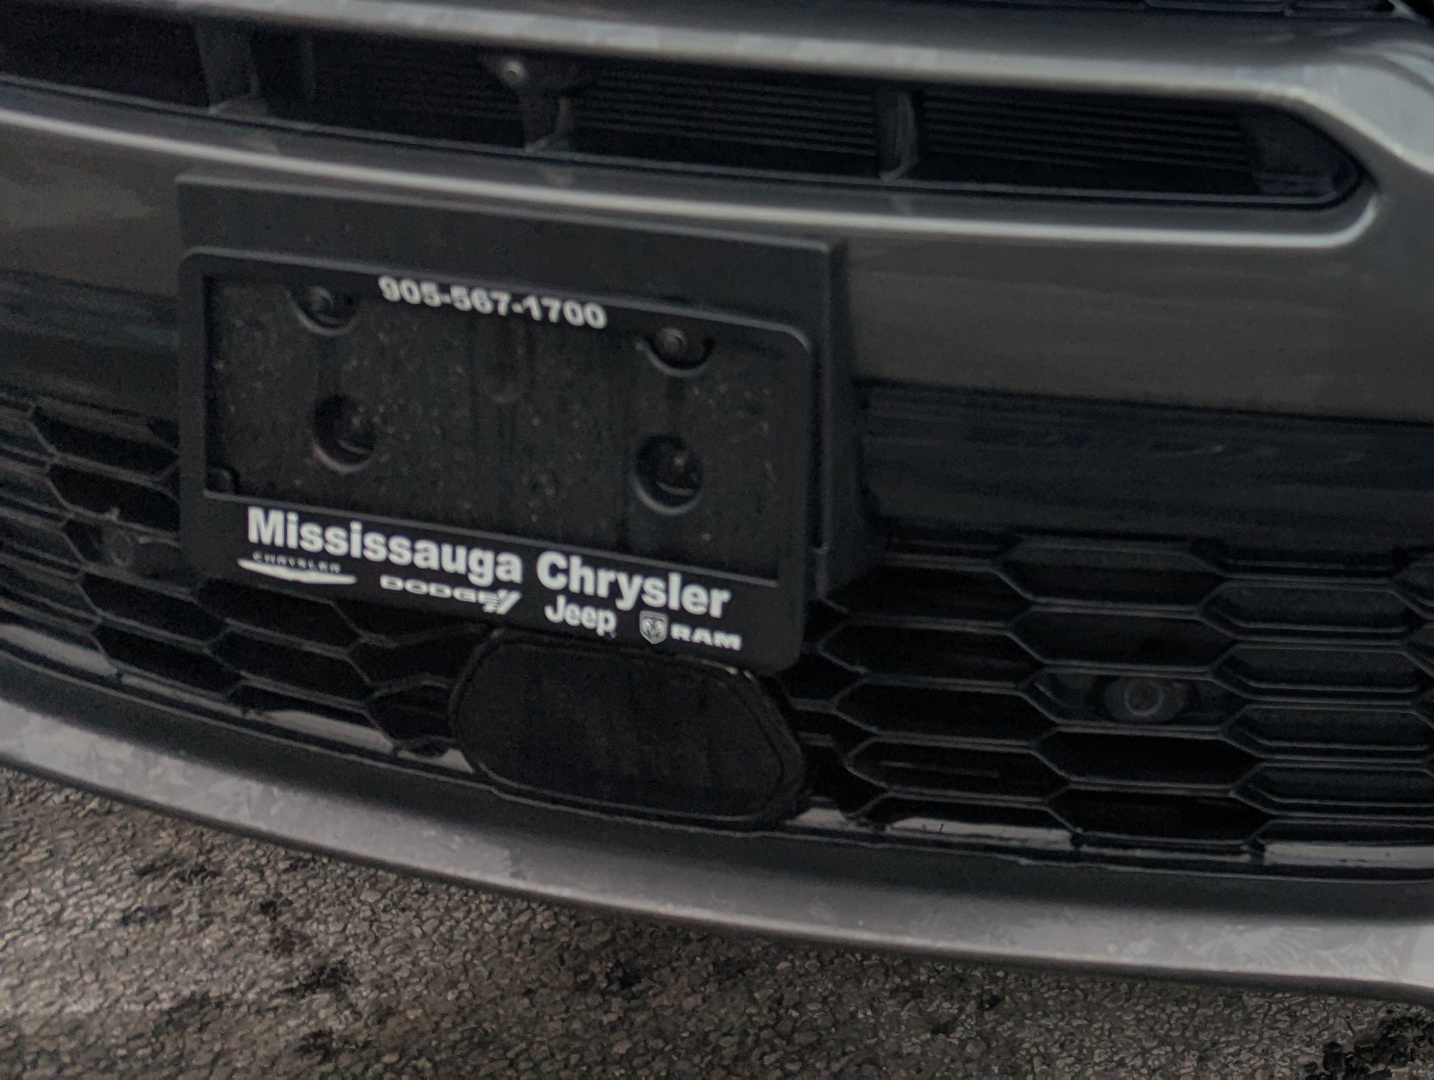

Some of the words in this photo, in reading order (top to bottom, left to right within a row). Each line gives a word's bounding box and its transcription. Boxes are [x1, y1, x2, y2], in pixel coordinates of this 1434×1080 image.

[378, 275, 608, 330] 905-567-1700
[247, 505, 523, 588] Mississauga
[536, 550, 732, 619] Chrysler
[379, 573, 500, 605] DODGE
[544, 594, 617, 638] Jeep
[670, 622, 743, 651] RAM
